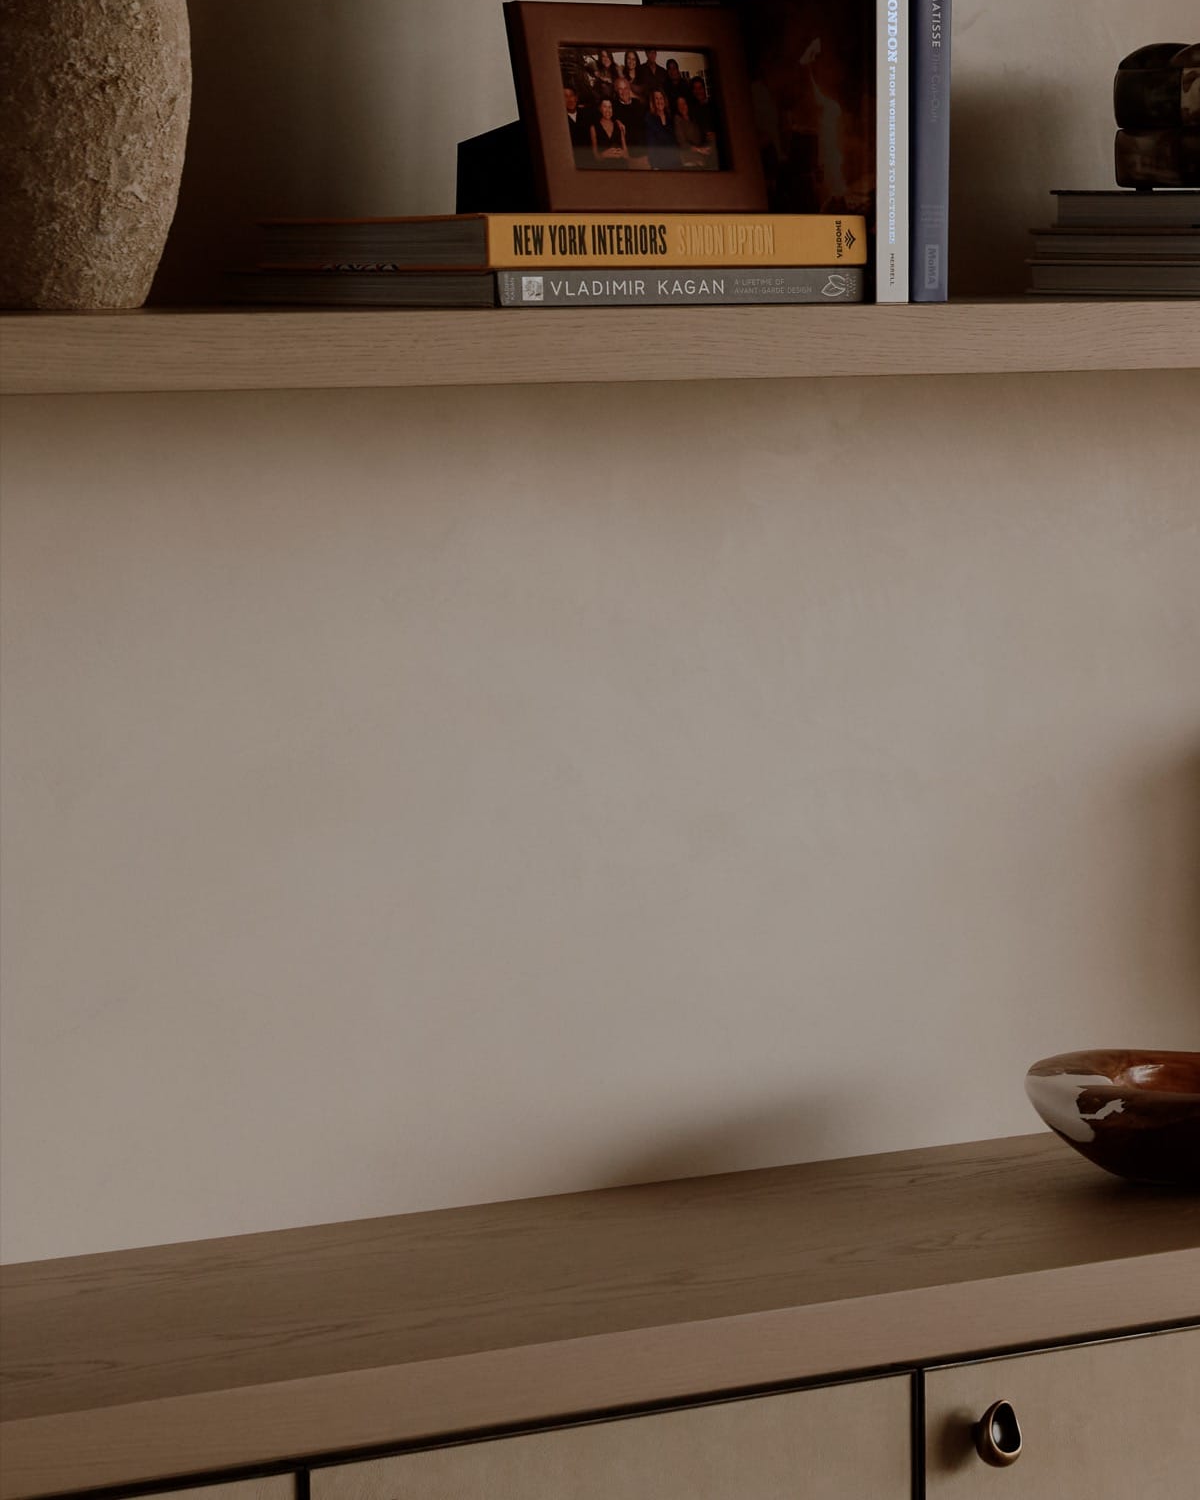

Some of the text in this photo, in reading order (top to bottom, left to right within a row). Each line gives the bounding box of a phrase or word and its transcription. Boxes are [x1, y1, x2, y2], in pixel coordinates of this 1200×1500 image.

[888, 65, 897, 97] FROM
[888, 98, 897, 166] WORKSHOPS
[888, 167, 897, 182] TO
[888, 184, 897, 244] FACTORIES
[513, 224, 667, 256] NEW YORK INTERIORS
[679, 223, 775, 256] SIMON UPTON
[835, 219, 843, 259] VENDOME
[927, 247, 937, 285] MoMA
[550, 279, 725, 296] VLADIMIR KAGAN
[734, 286, 812, 294] AVANT-GARDE DESIGN
